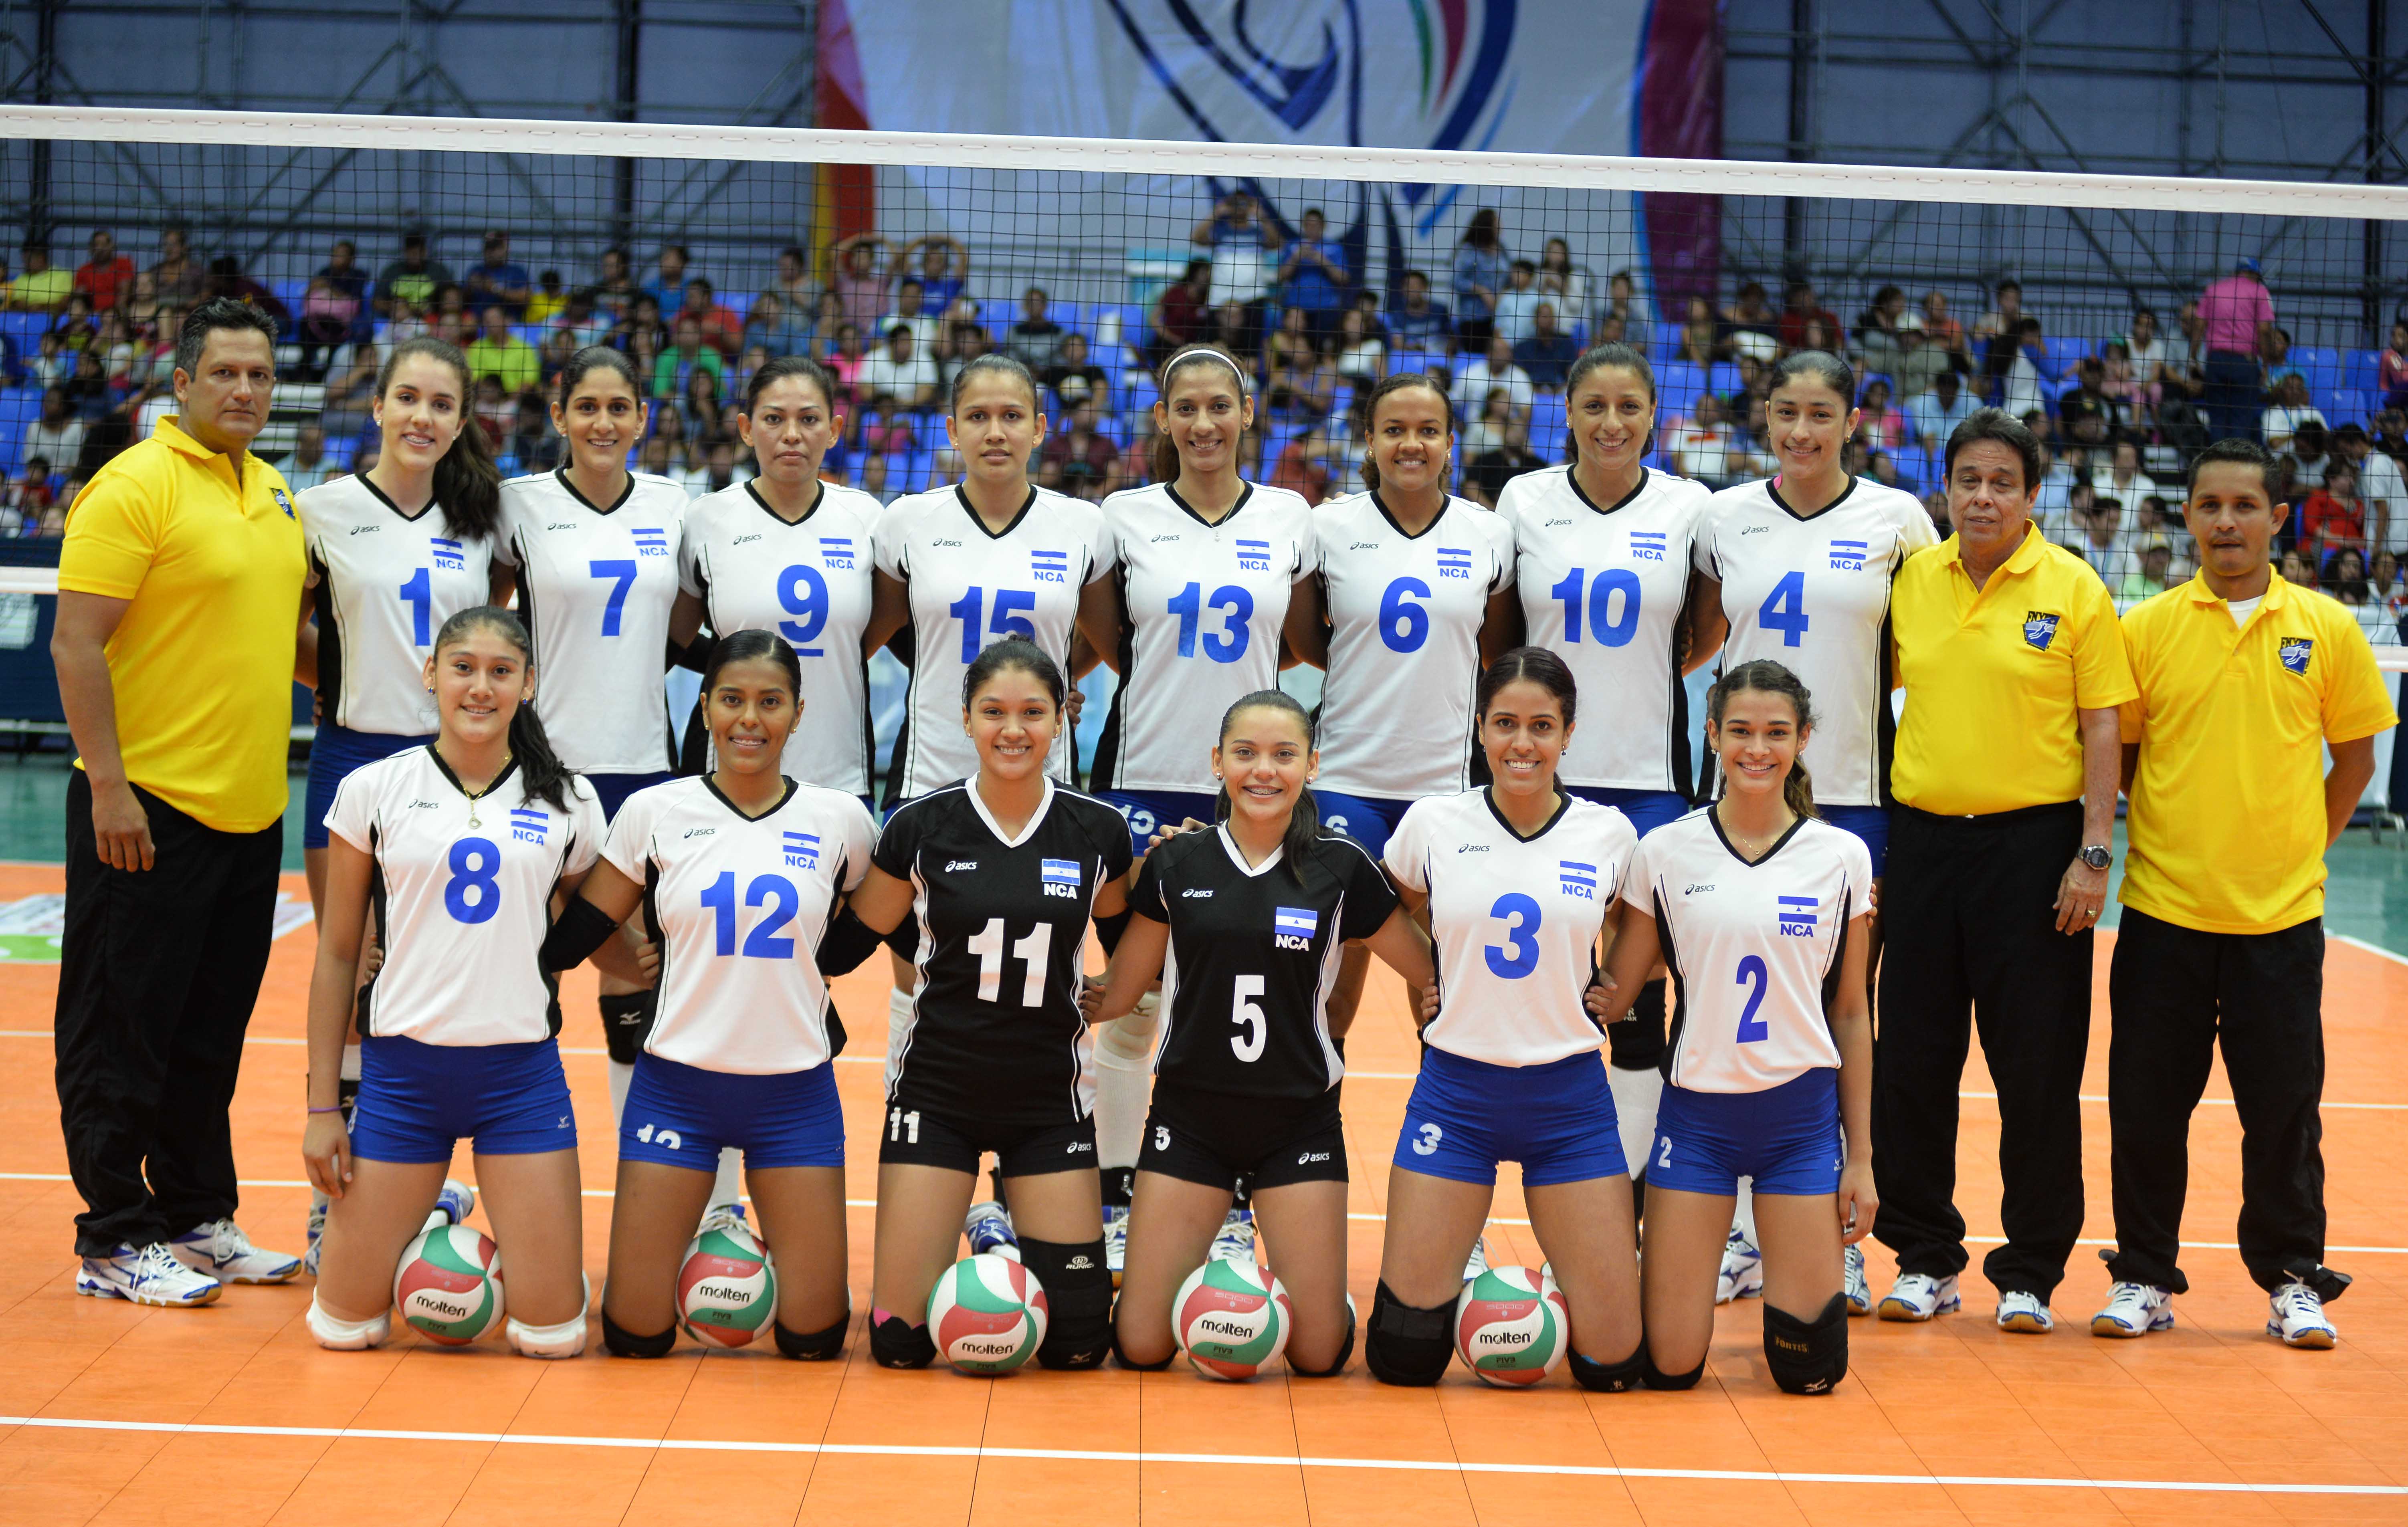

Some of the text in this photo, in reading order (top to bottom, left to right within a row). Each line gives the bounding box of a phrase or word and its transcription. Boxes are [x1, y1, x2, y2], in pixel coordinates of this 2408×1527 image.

[743, 533, 762, 543] asics
[639, 548, 669, 556] NCA
[1633, 549, 1663, 562] NCA
[436, 559, 465, 571] NCA
[826, 559, 855, 570] NCA
[1240, 560, 1270, 572] NCA
[1830, 560, 1862, 571] NCA
[1034, 571, 1065, 583] NCA
[1440, 568, 1469, 579] NCA
[589, 560, 637, 636] 7
[777, 564, 828, 643] 9
[400, 568, 430, 646] 1
[1379, 577, 1432, 653] 6
[1552, 567, 1641, 648] 10
[1759, 571, 1809, 647] 4
[950, 586, 1036, 664] 15
[1167, 582, 1254, 664] 13
[513, 829, 544, 846] NCA
[694, 828, 715, 836] asics
[785, 855, 816, 870] NCA
[955, 861, 977, 870] asics
[444, 837, 501, 924] 8
[1044, 884, 1077, 899] NCA
[1562, 884, 1593, 900] NCA
[1695, 885, 1715, 893] asics
[701, 871, 798, 959] 12
[1484, 893, 1542, 979] 3
[1780, 924, 1814, 938] NCA
[1275, 935, 1309, 951] NCA
[968, 918, 1052, 1007] 11
[1736, 955, 1768, 1044] 2
[1230, 975, 1267, 1062] 5
[890, 1107, 920, 1144] 11
[1155, 1126, 1170, 1151] 5
[1413, 1123, 1442, 1156] 3
[1078, 1143, 1091, 1151] asics
[1658, 1136, 1672, 1168] 2
[1310, 1152, 1330, 1162] asics
[700, 1286, 750, 1303] molten
[1215, 1292, 1253, 1304] 5000
[417, 1296, 466, 1317] molten
[1201, 1320, 1253, 1338] molten
[1480, 1332, 1531, 1344] molten
[962, 1343, 1013, 1355] molten
[1213, 1346, 1233, 1354] FIVB
